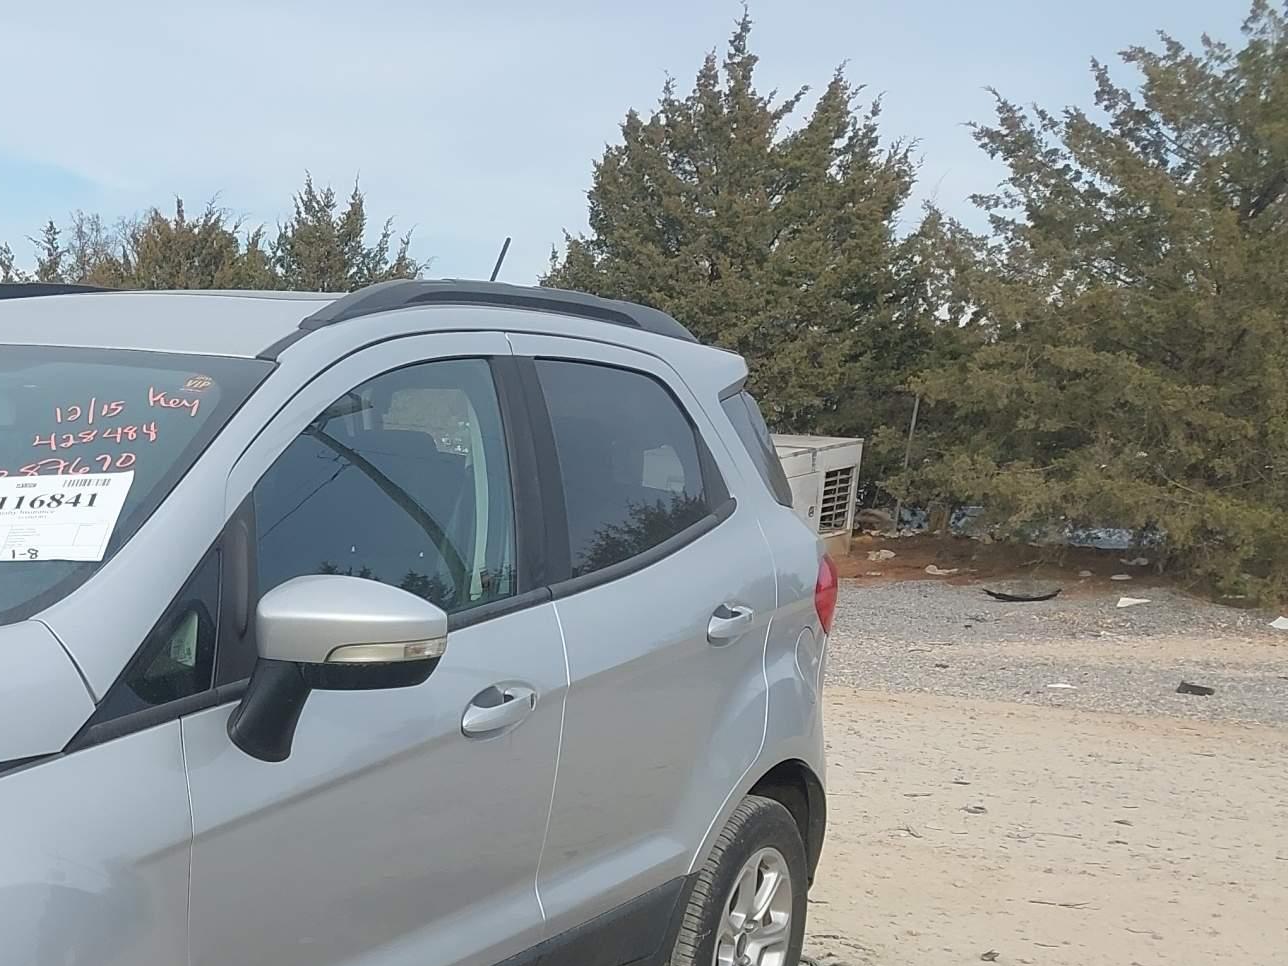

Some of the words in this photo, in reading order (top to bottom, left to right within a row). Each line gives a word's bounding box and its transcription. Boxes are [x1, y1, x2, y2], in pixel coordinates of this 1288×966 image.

[55, 397, 126, 425] 12/15
[147, 386, 200, 416] Key
[11, 547, 40, 560] 1-8
